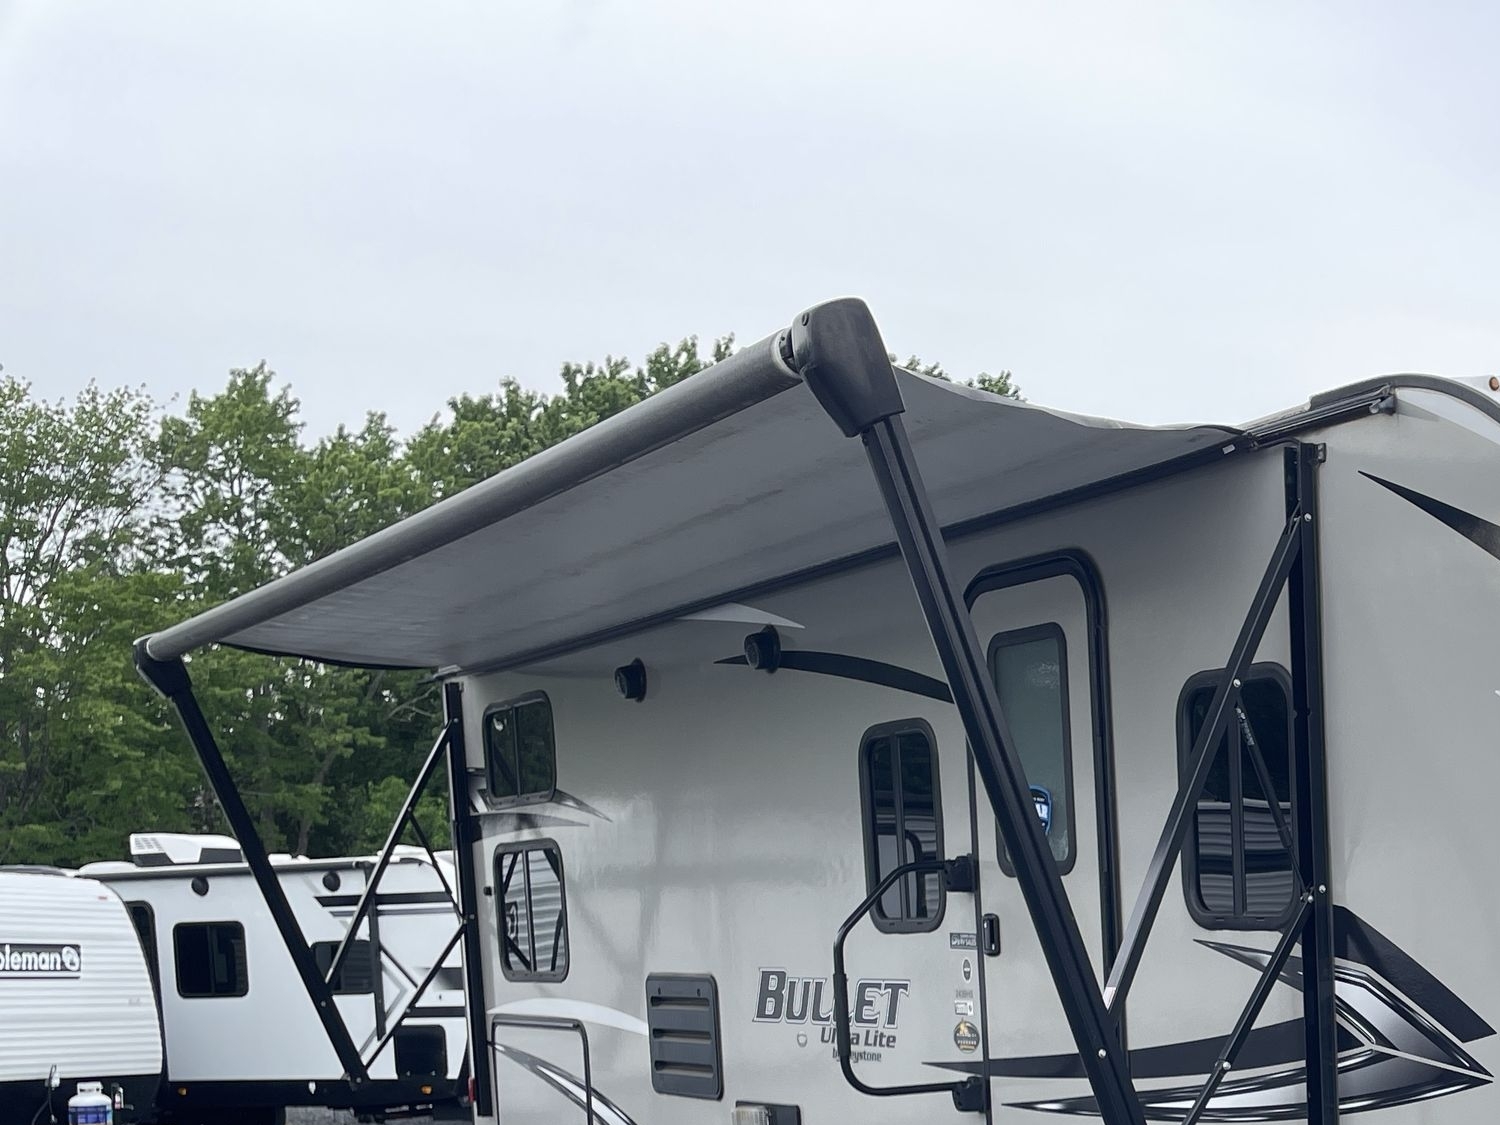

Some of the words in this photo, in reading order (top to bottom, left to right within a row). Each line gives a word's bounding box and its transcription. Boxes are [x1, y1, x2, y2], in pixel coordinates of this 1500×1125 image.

[821, 1026, 860, 1046] Ula
[864, 1029, 897, 1048] Lite
[850, 1050, 882, 1063] eystone
